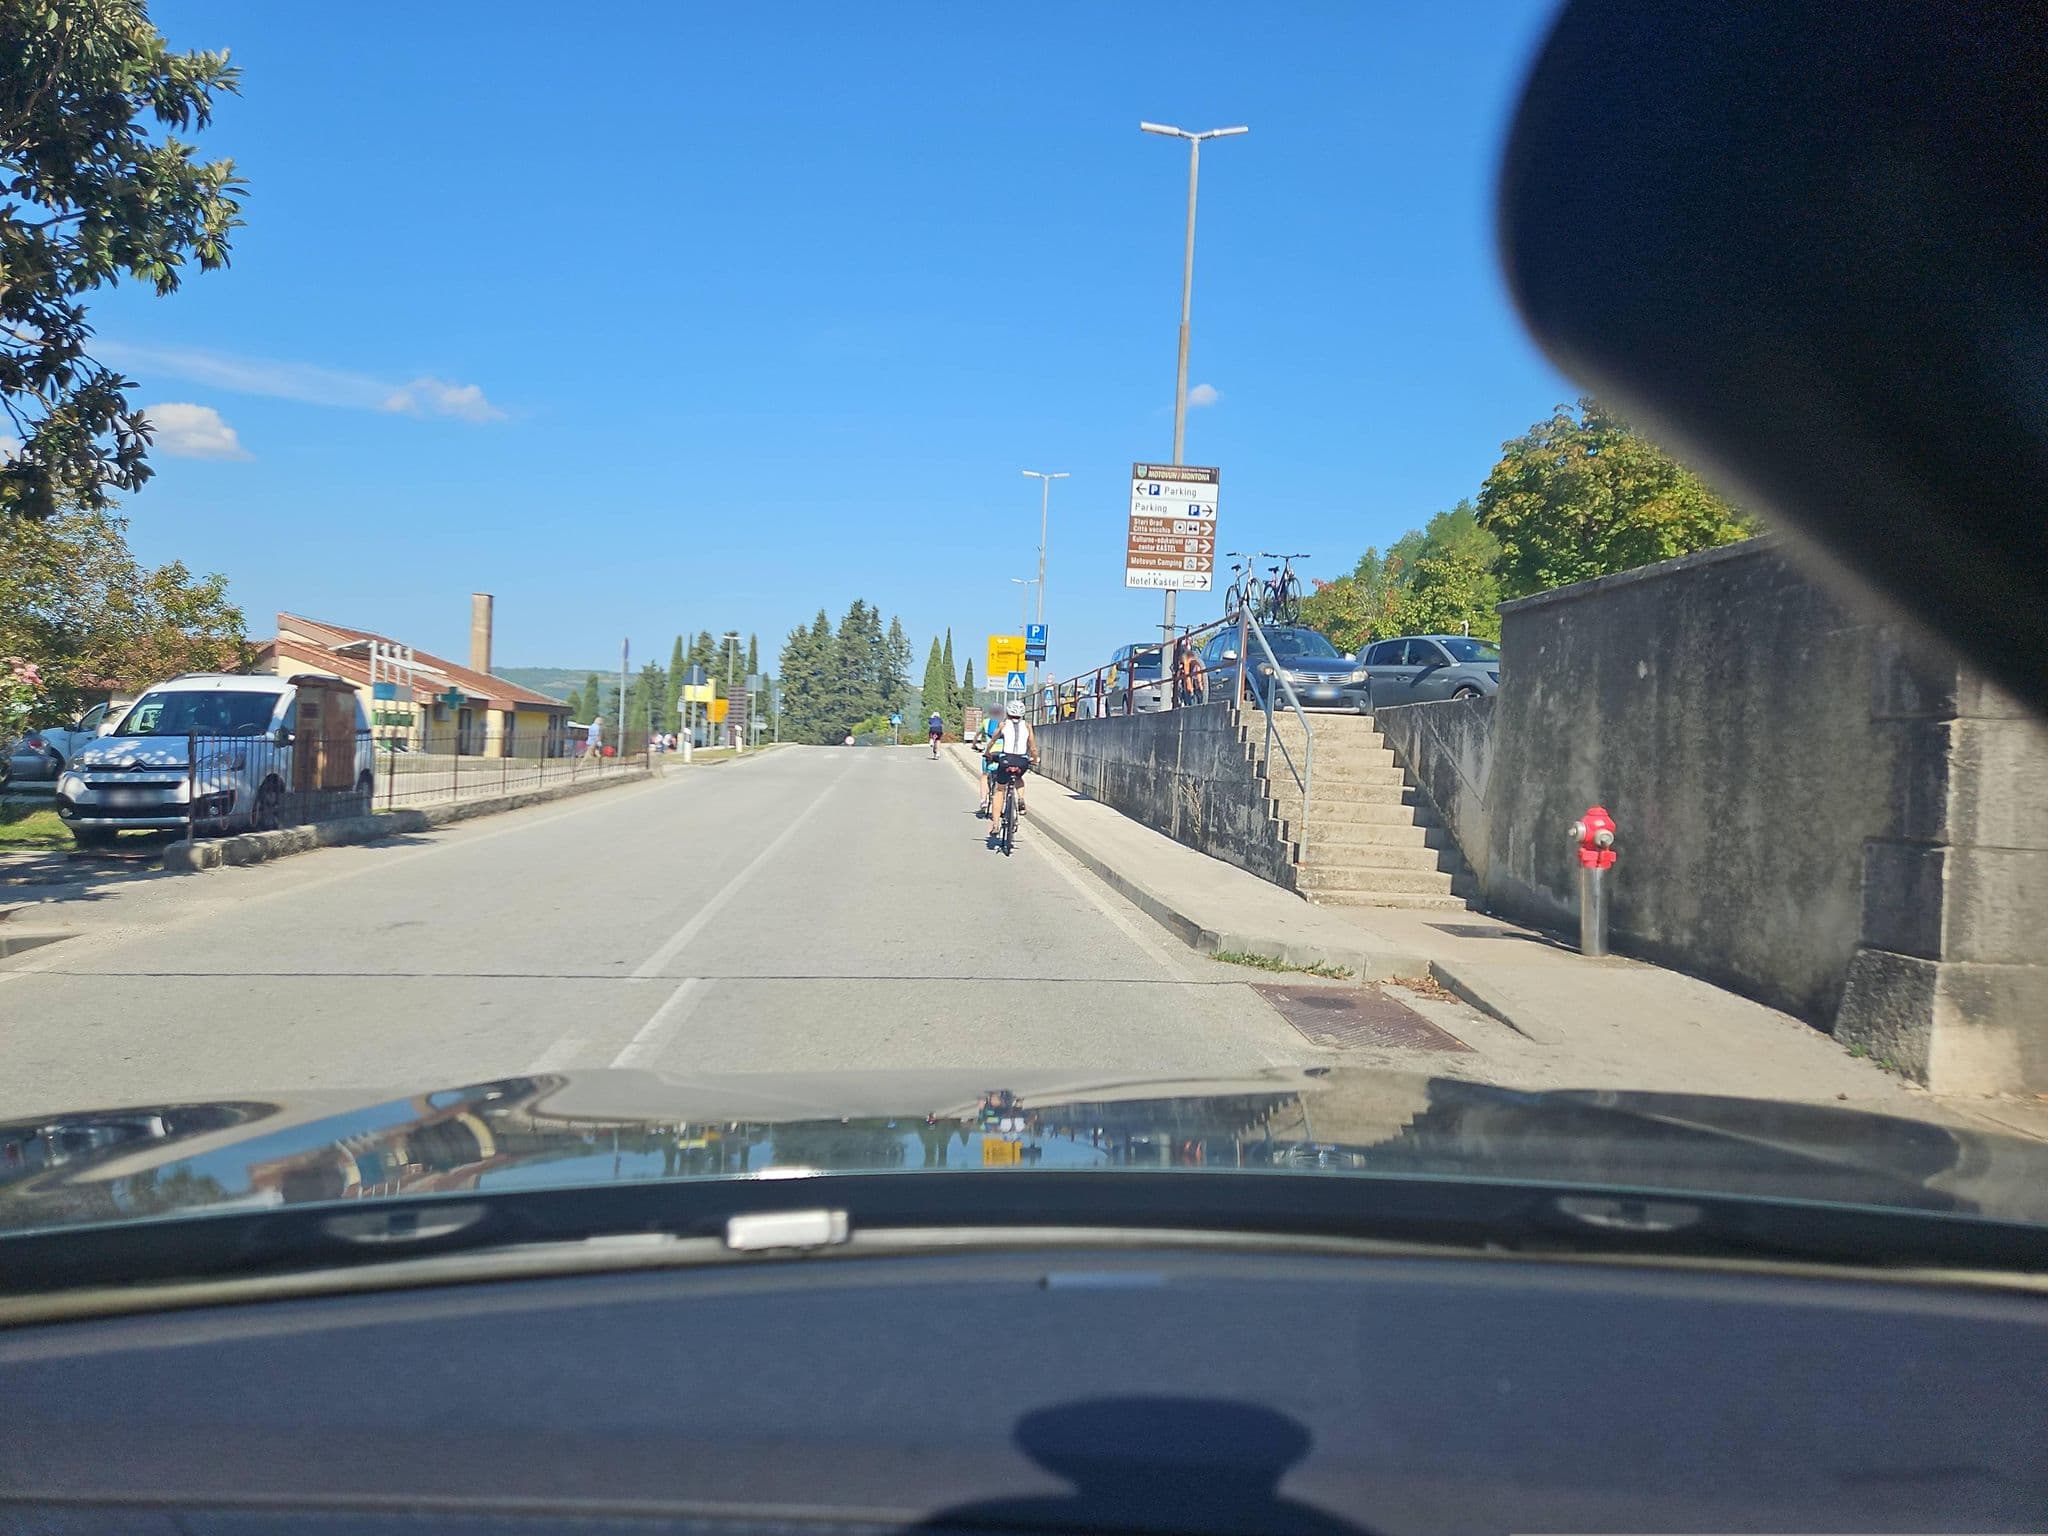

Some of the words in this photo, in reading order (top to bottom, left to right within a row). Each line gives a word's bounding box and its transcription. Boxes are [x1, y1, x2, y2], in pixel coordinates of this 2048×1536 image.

[1181, 473, 1210, 481] MONTONA
[1164, 487, 1197, 498] Parking
[1135, 503, 1167, 513] Parking
[1131, 557, 1156, 565] Motovun
[1157, 558, 1183, 568] Camping
[1130, 577, 1151, 585] Hotel
[1153, 577, 1179, 587] Kaštel
